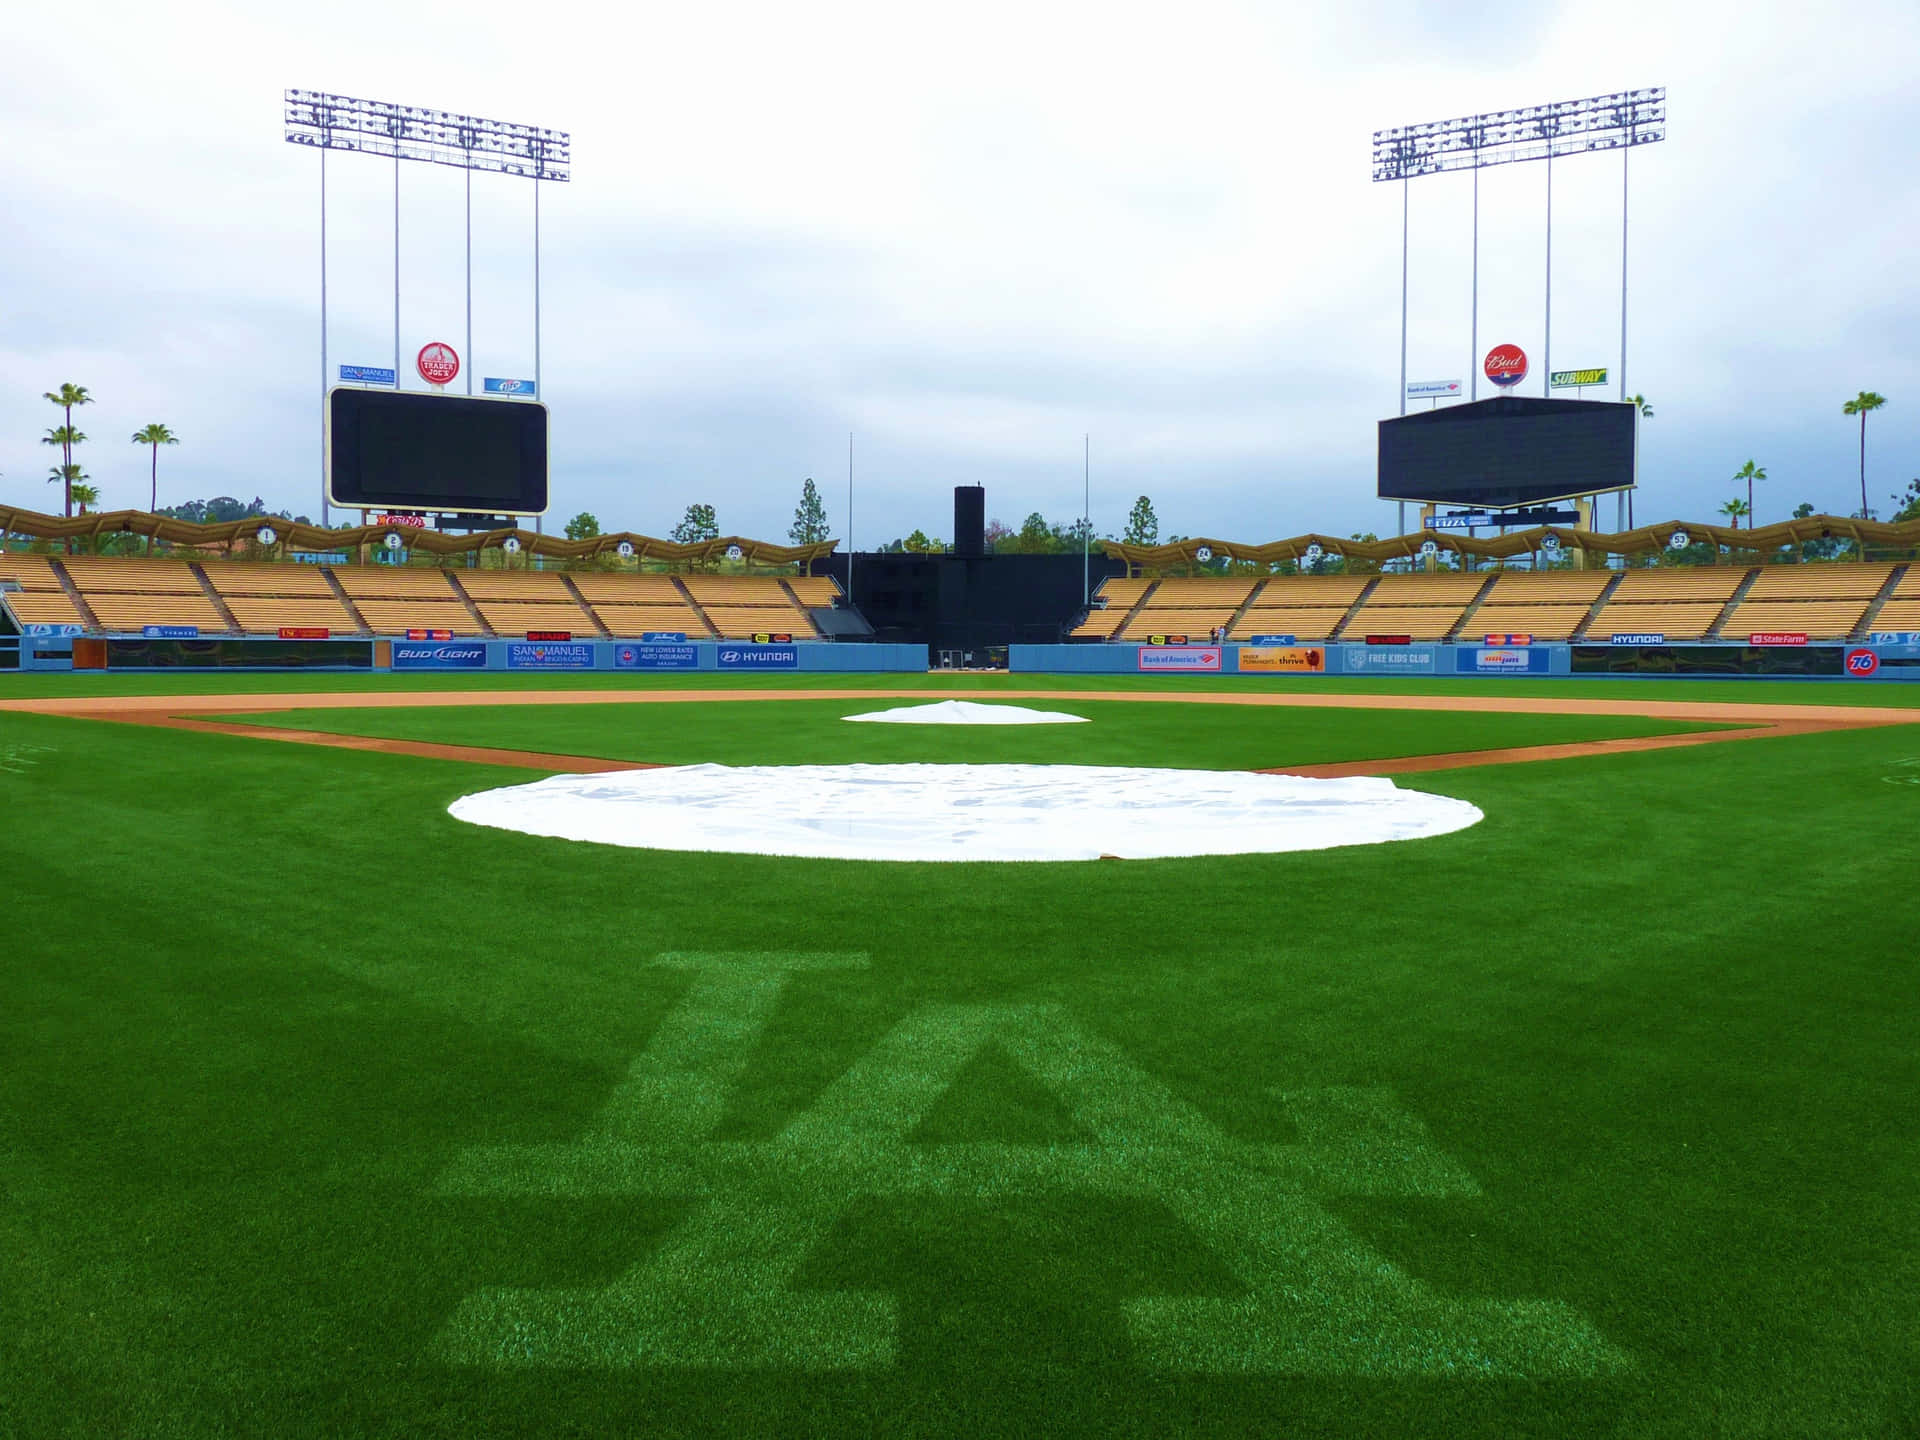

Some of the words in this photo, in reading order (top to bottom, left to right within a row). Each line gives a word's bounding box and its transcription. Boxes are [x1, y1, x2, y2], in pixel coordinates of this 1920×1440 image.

[424, 362, 453, 370] TRADER
[1487, 354, 1521, 368] Bud
[362, 367, 393, 378] MANUEL
[428, 369, 449, 377] JOE'S
[1552, 369, 1605, 385] SUBWAY
[1613, 635, 1663, 643] HYUNDAI
[397, 649, 433, 658] BUD
[439, 650, 483, 658] LIGHT
[513, 646, 536, 656] SAN
[544, 646, 589, 656] MANUEL
[743, 652, 795, 662] HYUNDAI
[1169, 655, 1197, 663] America
[1279, 656, 1305, 665] thrive
[1369, 654, 1387, 664] FREE
[1389, 654, 1408, 664] KIDS
[1409, 654, 1430, 664] CLUB
[1850, 653, 1873, 670] 76
[425, 950, 1632, 1378] LA
